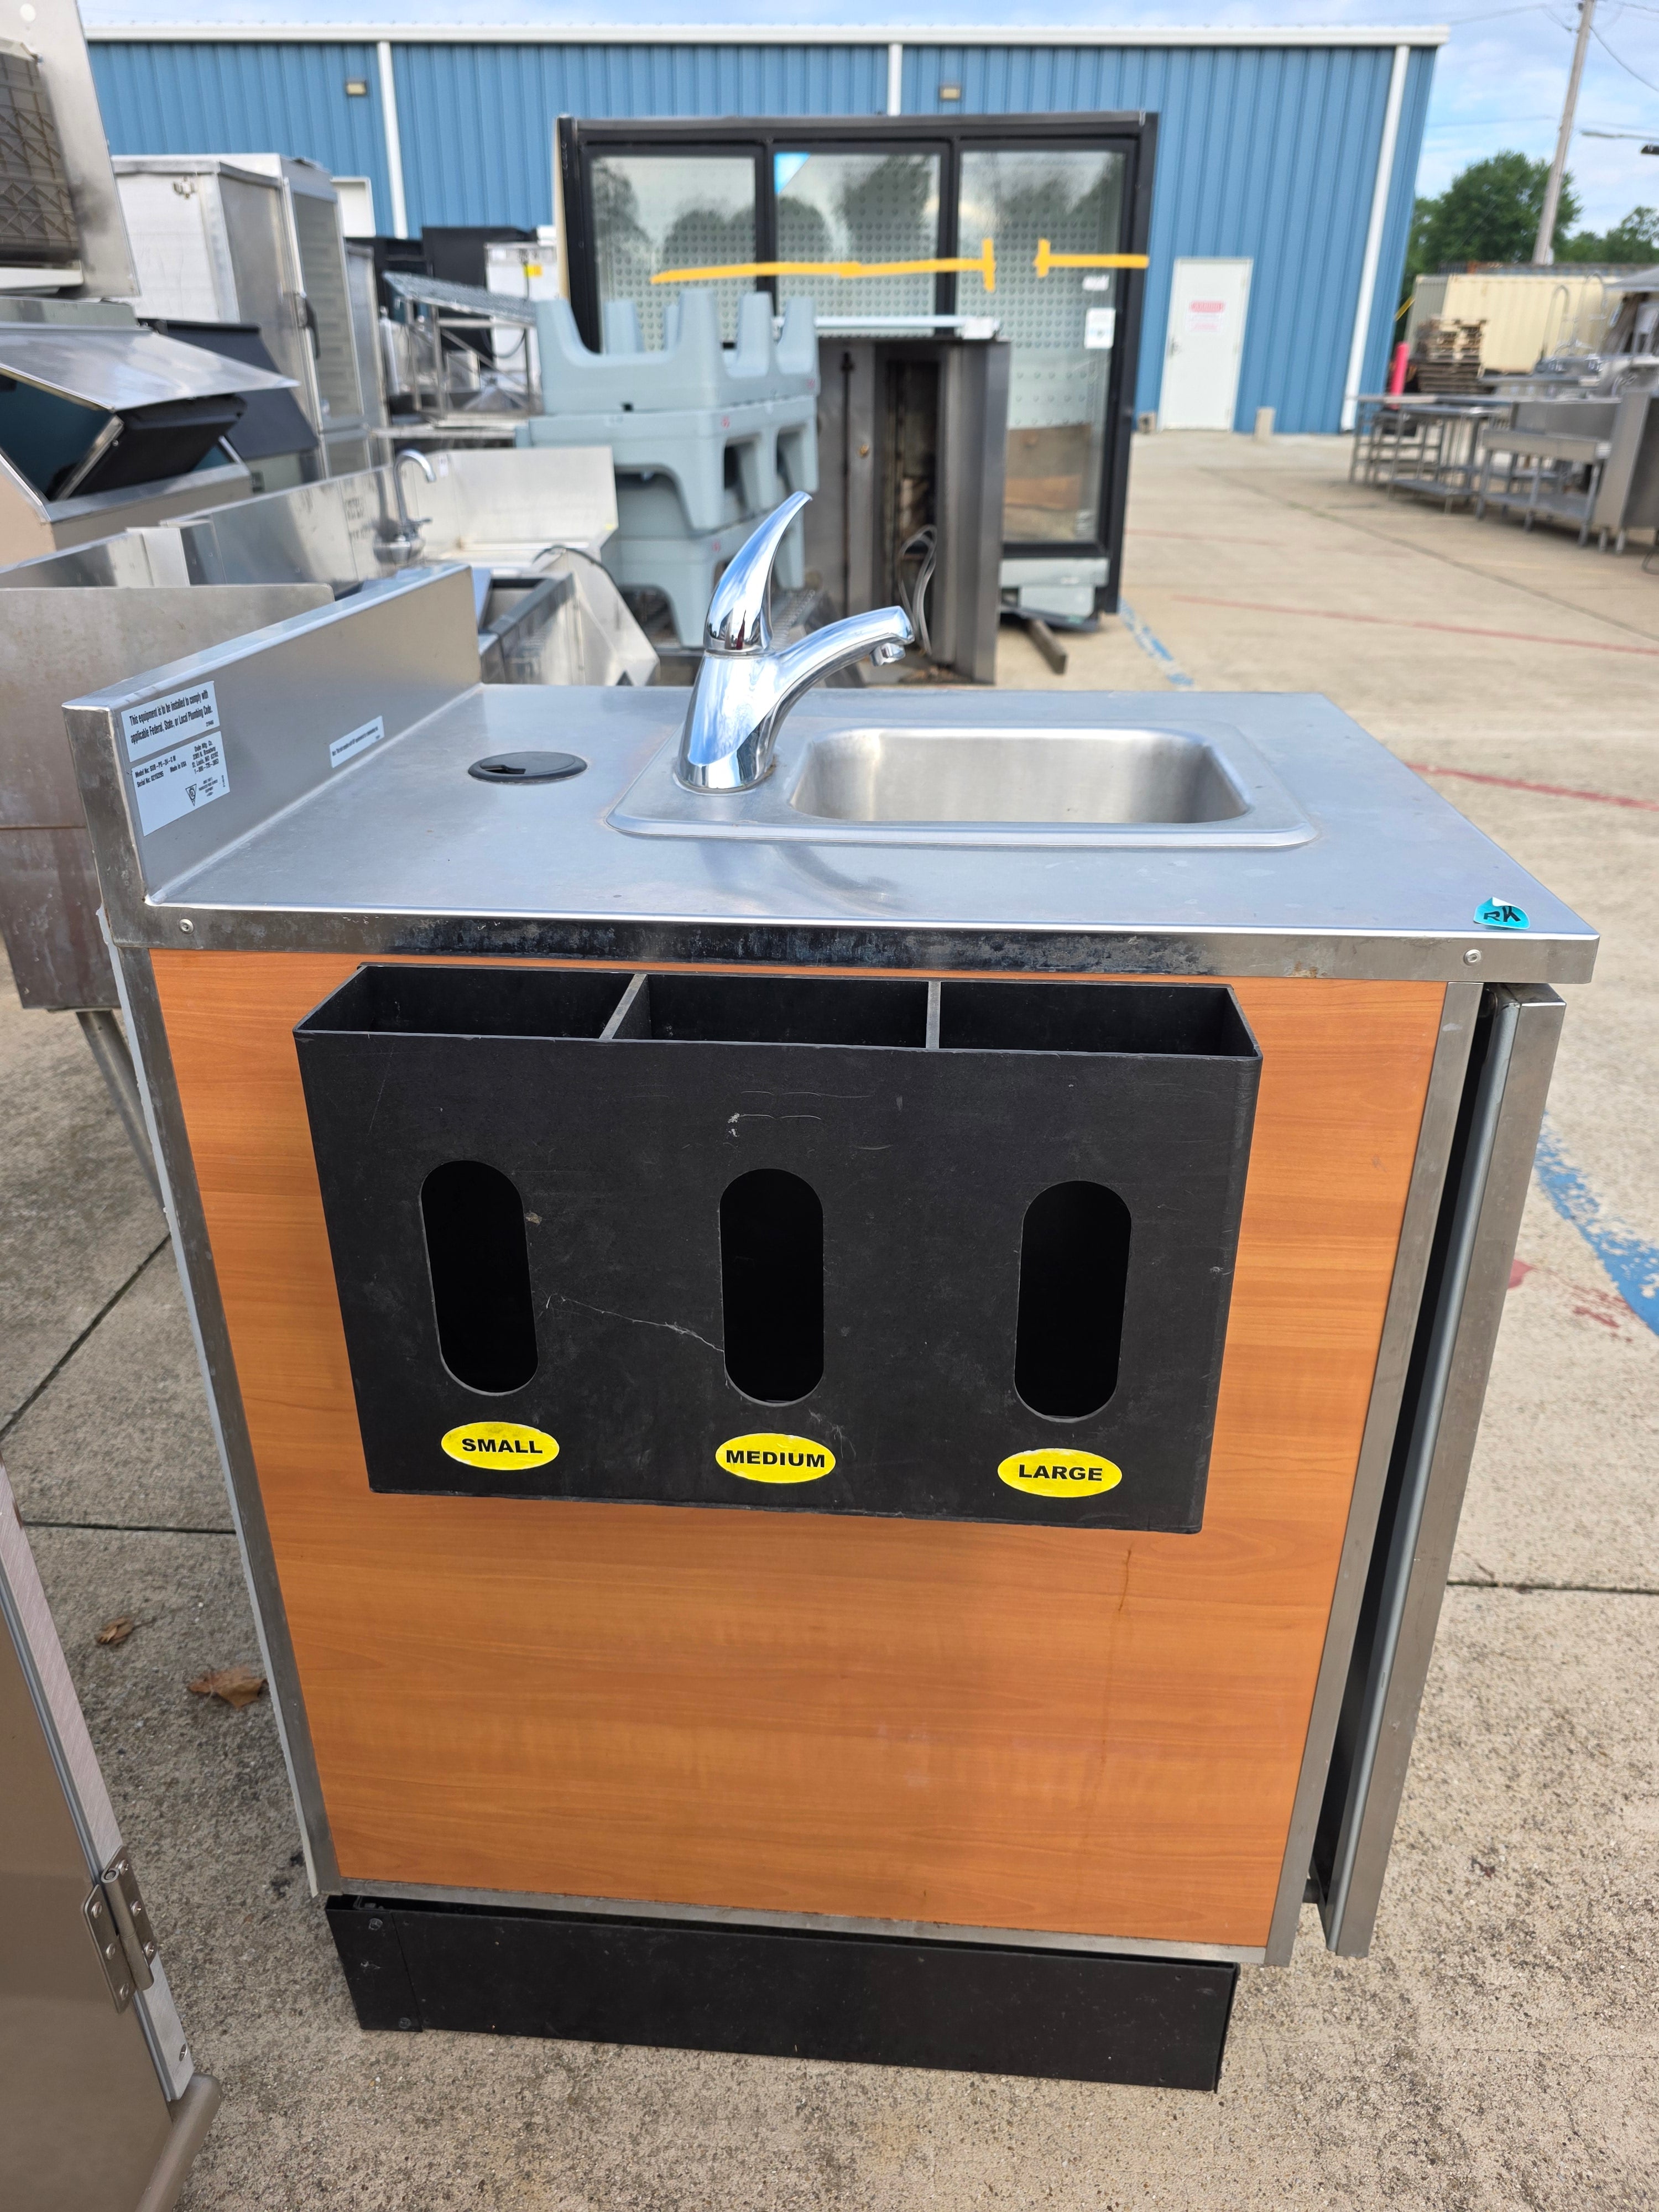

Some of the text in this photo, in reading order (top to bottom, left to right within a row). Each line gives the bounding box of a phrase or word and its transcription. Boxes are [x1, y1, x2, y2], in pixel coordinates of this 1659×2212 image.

[129, 714, 138, 726] This
[138, 707, 158, 724] equipment
[158, 706, 161, 716] is
[161, 704, 165, 714] to
[165, 703, 171, 713] be
[171, 697, 185, 711] installed
[185, 697, 189, 706] to
[190, 692, 201, 704] comply
[131, 727, 149, 744] applicable
[149, 722, 164, 735] Federal,
[164, 719, 175, 731] State,
[175, 717, 179, 726] or
[179, 713, 188, 725] Local
[188, 708, 204, 721] Plumbing
[462, 1438, 543, 1454] SMALL
[726, 1449, 825, 1468] MEDIUM
[1019, 1464, 1103, 1481] LARGE
